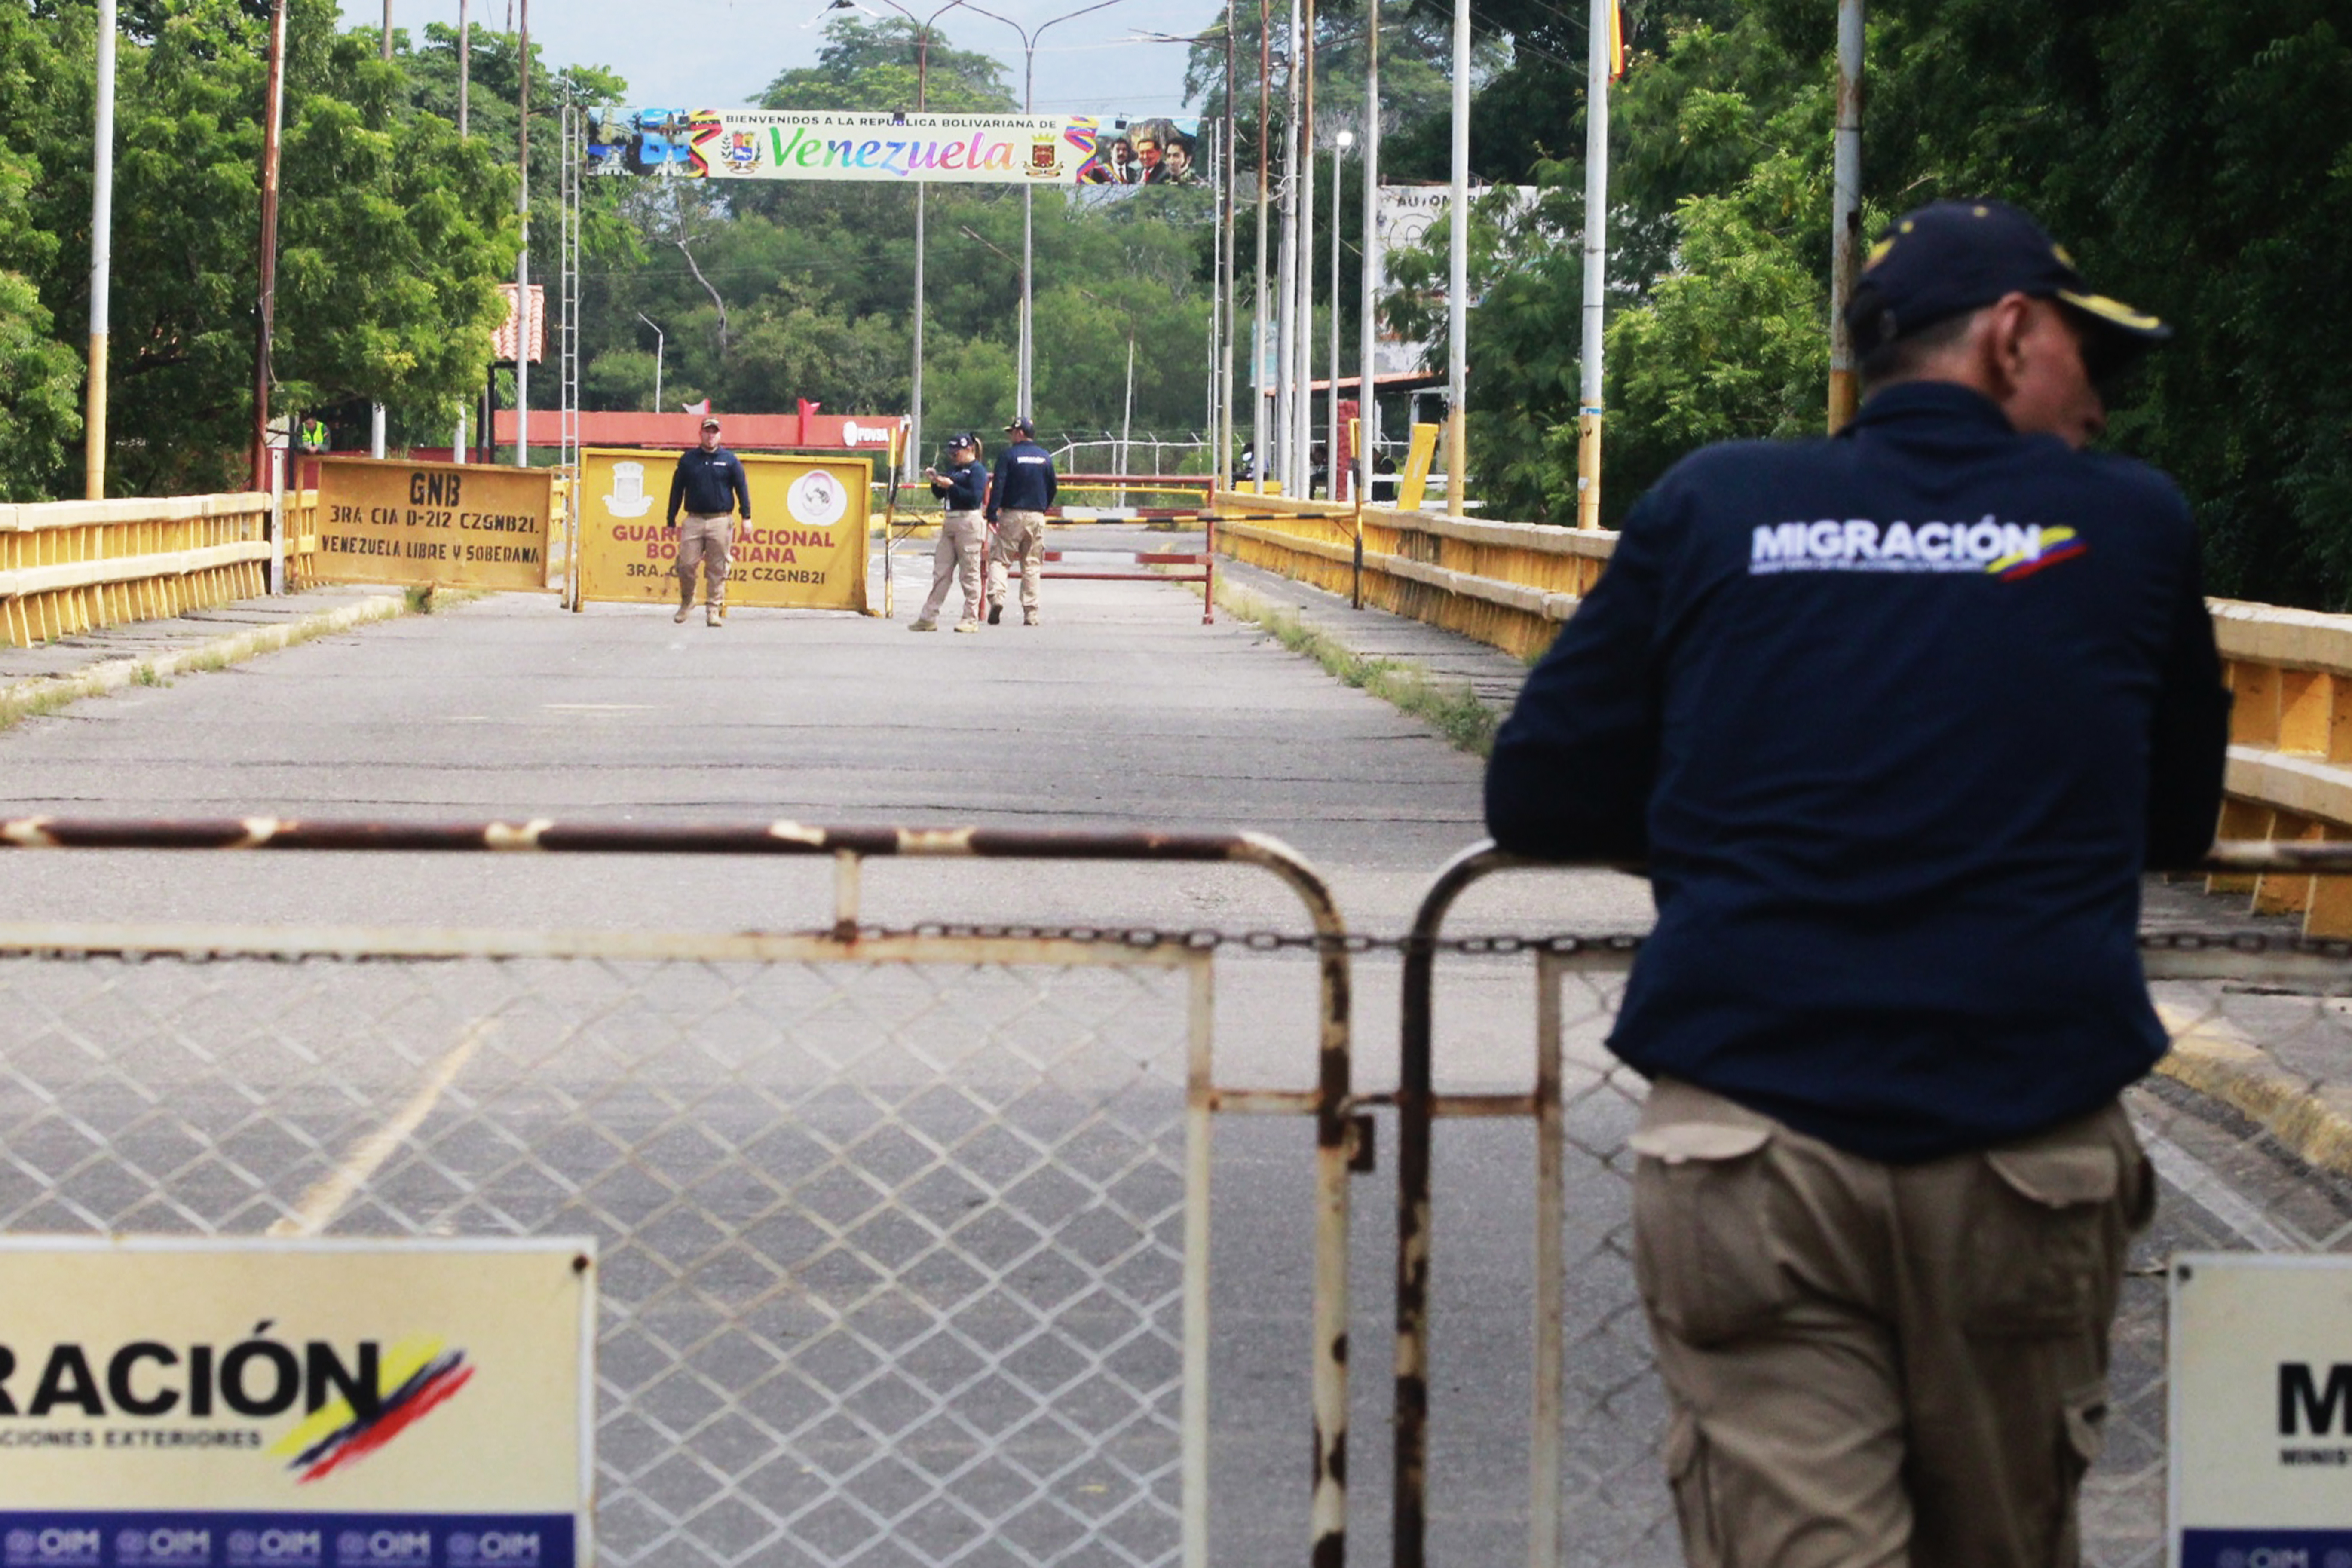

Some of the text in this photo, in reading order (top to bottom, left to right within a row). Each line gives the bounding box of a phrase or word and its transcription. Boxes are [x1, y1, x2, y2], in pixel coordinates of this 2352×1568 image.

[726, 115, 819, 125] BIENVENIDOS
[824, 117, 833, 125] A
[838, 117, 854, 126] LA
[942, 119, 1034, 128] BOLIVARIANA
[1039, 120, 1057, 129] DE
[769, 126, 1017, 176] Venezuela
[858, 427, 889, 441] PDVSA
[410, 472, 461, 507] GNB
[330, 505, 362, 524] 3RA
[371, 508, 398, 524] CIA
[407, 510, 452, 528] D-212
[612, 524, 836, 548] GUAR ACIONAL
[1751, 514, 2040, 560] MIGRACIÓN
[322, 535, 400, 557] VENEZUELA
[406, 542, 447, 560] LIBRE
[466, 545, 539, 564] SOBERANA
[752, 567, 825, 584] CZGNB21
[0, 1320, 379, 1418] ACIÓN
[104, 1430, 262, 1447] EXTERIORES
[39, 1528, 539, 1559] OIM OIM OIM OIM OIM
